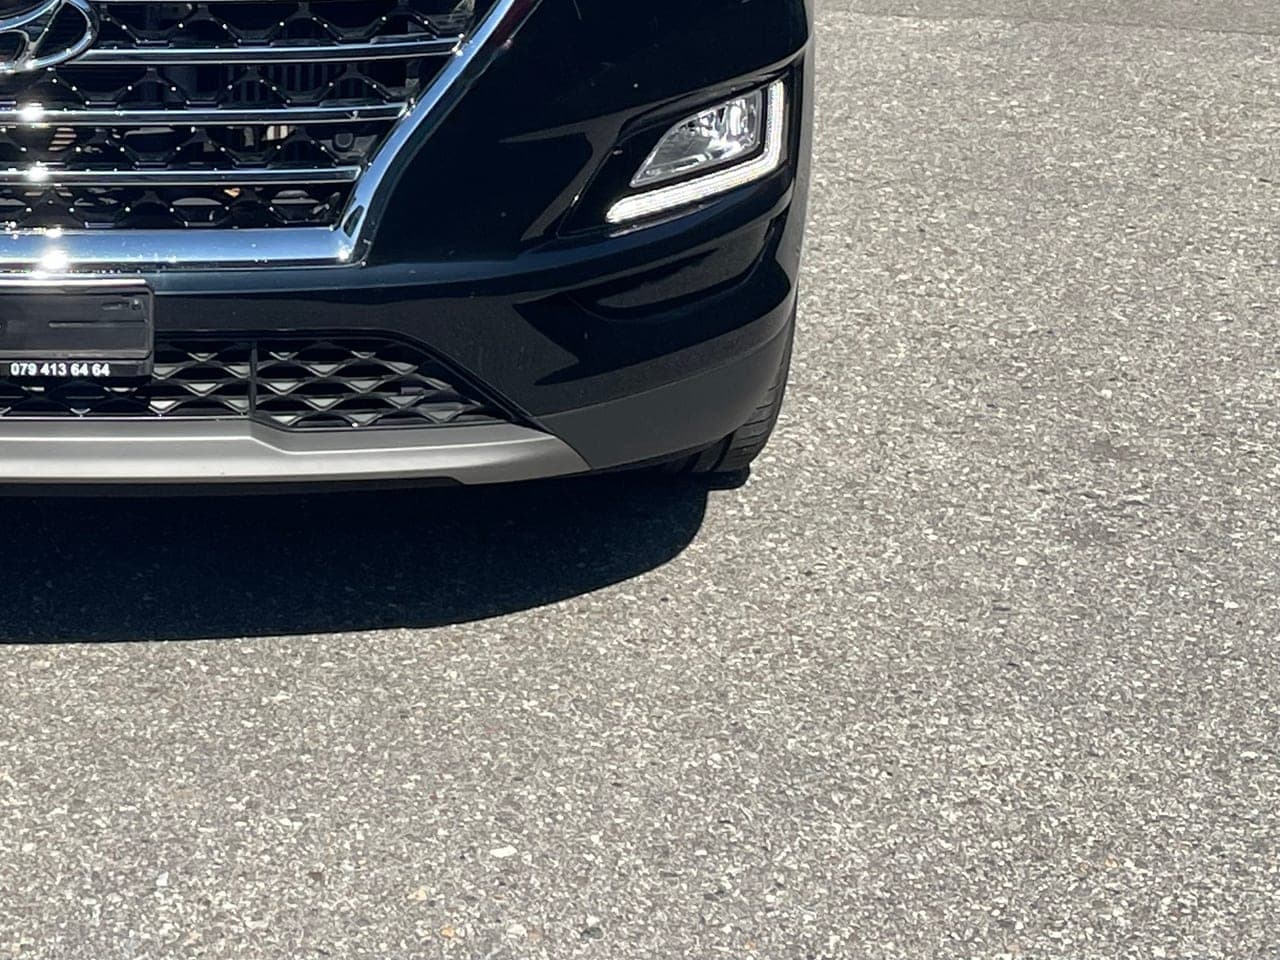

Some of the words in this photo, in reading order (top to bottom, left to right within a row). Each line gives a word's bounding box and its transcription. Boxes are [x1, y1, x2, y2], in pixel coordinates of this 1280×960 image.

[10, 362, 37, 376] 079
[39, 362, 67, 376] 413
[70, 363, 89, 377] 64
[91, 363, 111, 377] 64
